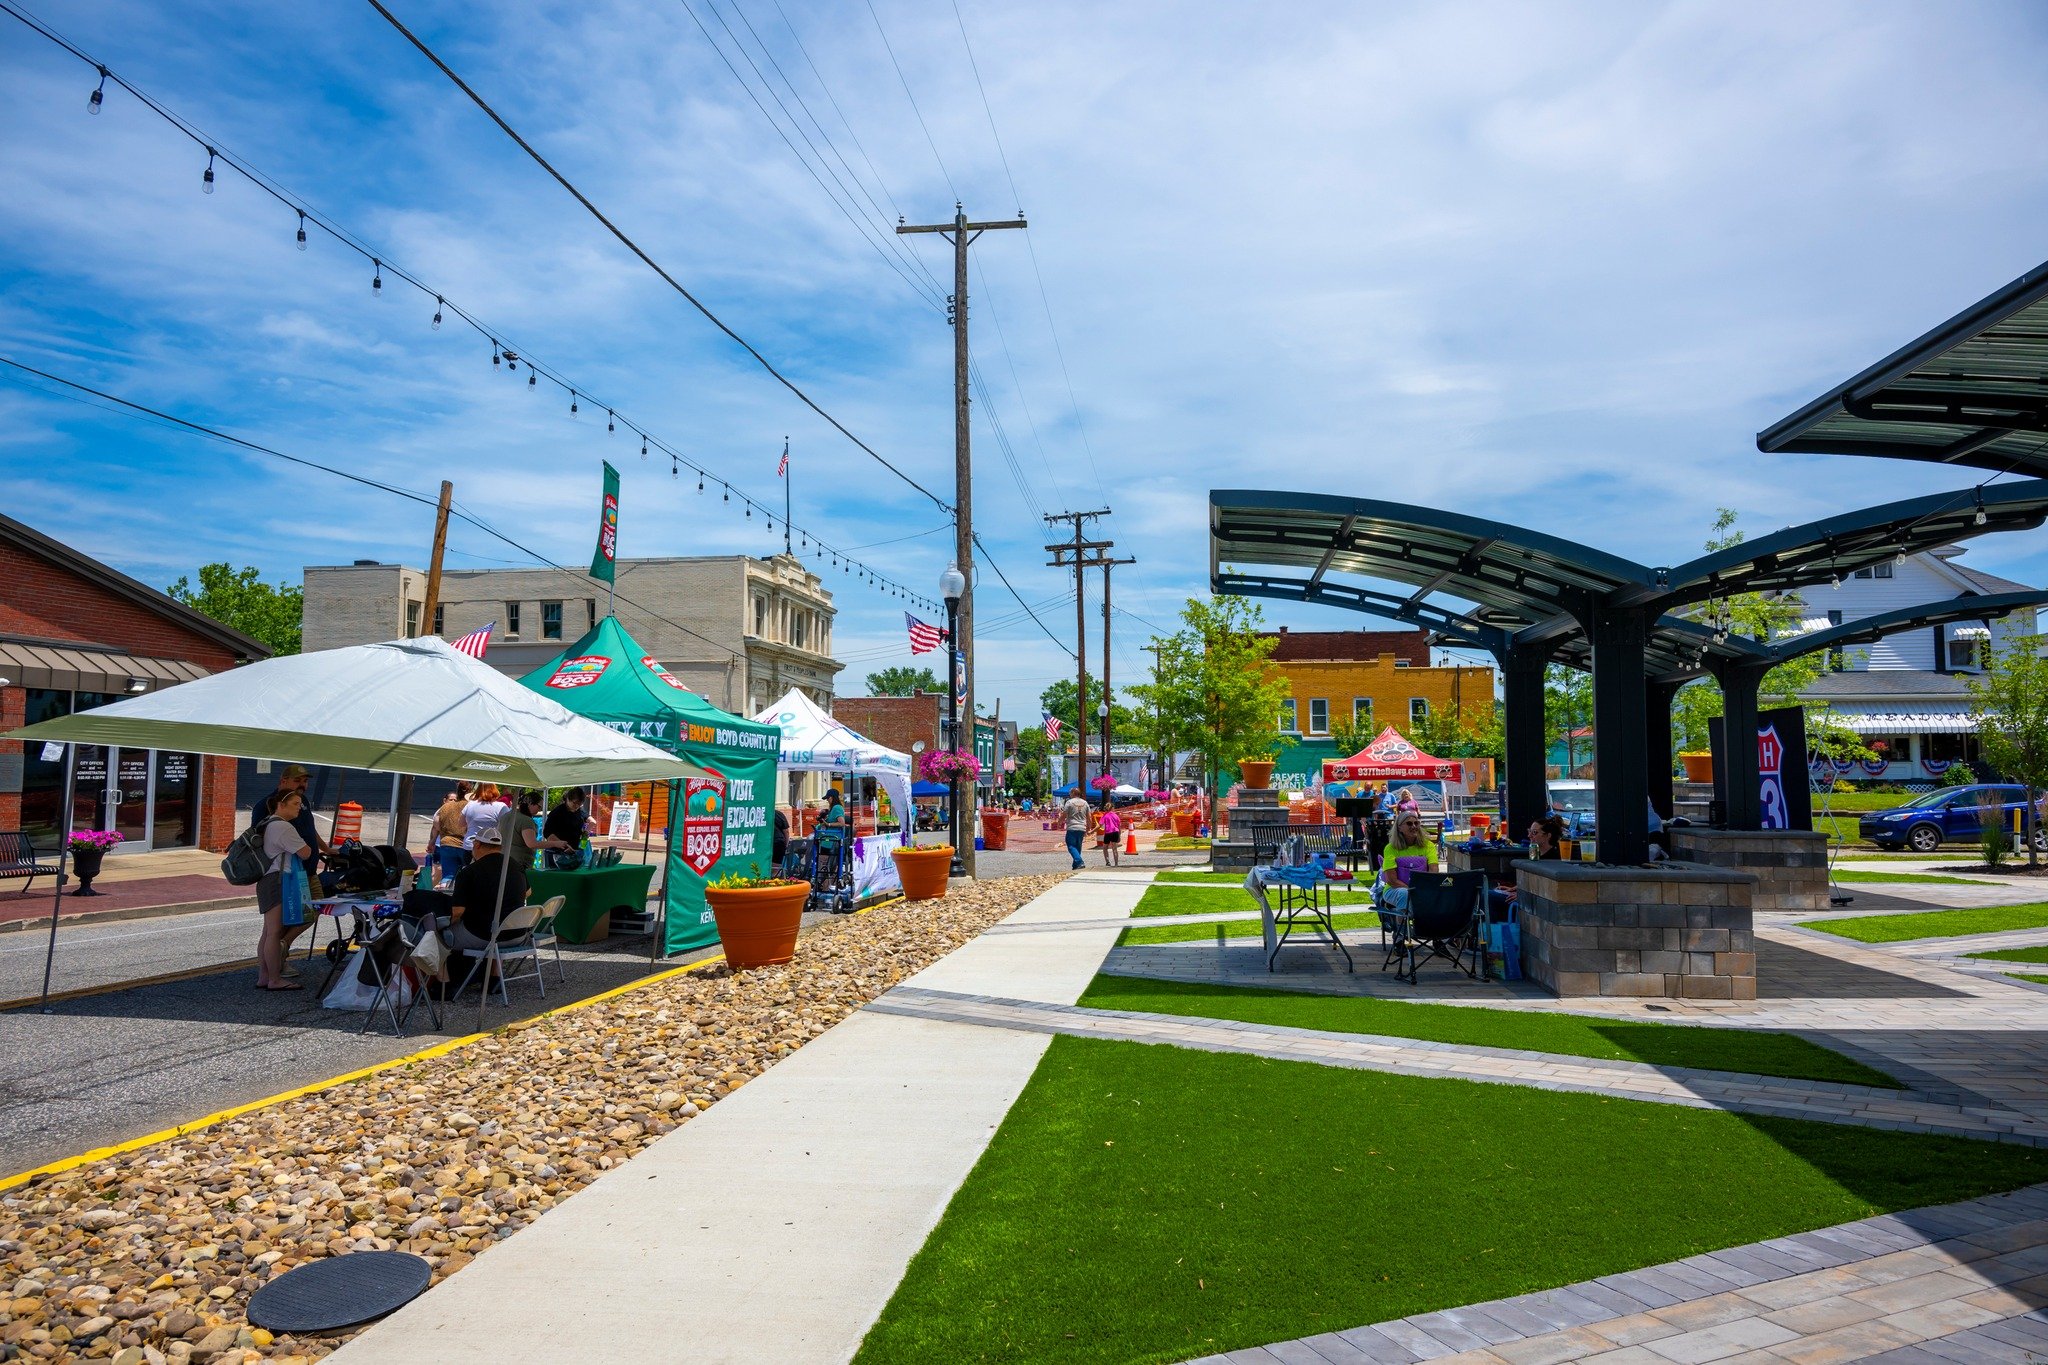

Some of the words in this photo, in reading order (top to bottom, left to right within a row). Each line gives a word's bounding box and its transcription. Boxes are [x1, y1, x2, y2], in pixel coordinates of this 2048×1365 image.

[640, 721, 668, 738] KY
[689, 723, 715, 744] ENJOY
[716, 728, 738, 746] BOYD
[739, 731, 768, 752] COUNTY,
[767, 735, 778, 750] KY
[792, 750, 814, 764] US!
[1358, 766, 1425, 777] 937TheDawg.com
[730, 779, 754, 801] VISIT.
[726, 806, 767, 829] EXPLORE.
[687, 833, 719, 857] BOCO
[724, 833, 755, 857] ENJOY.
